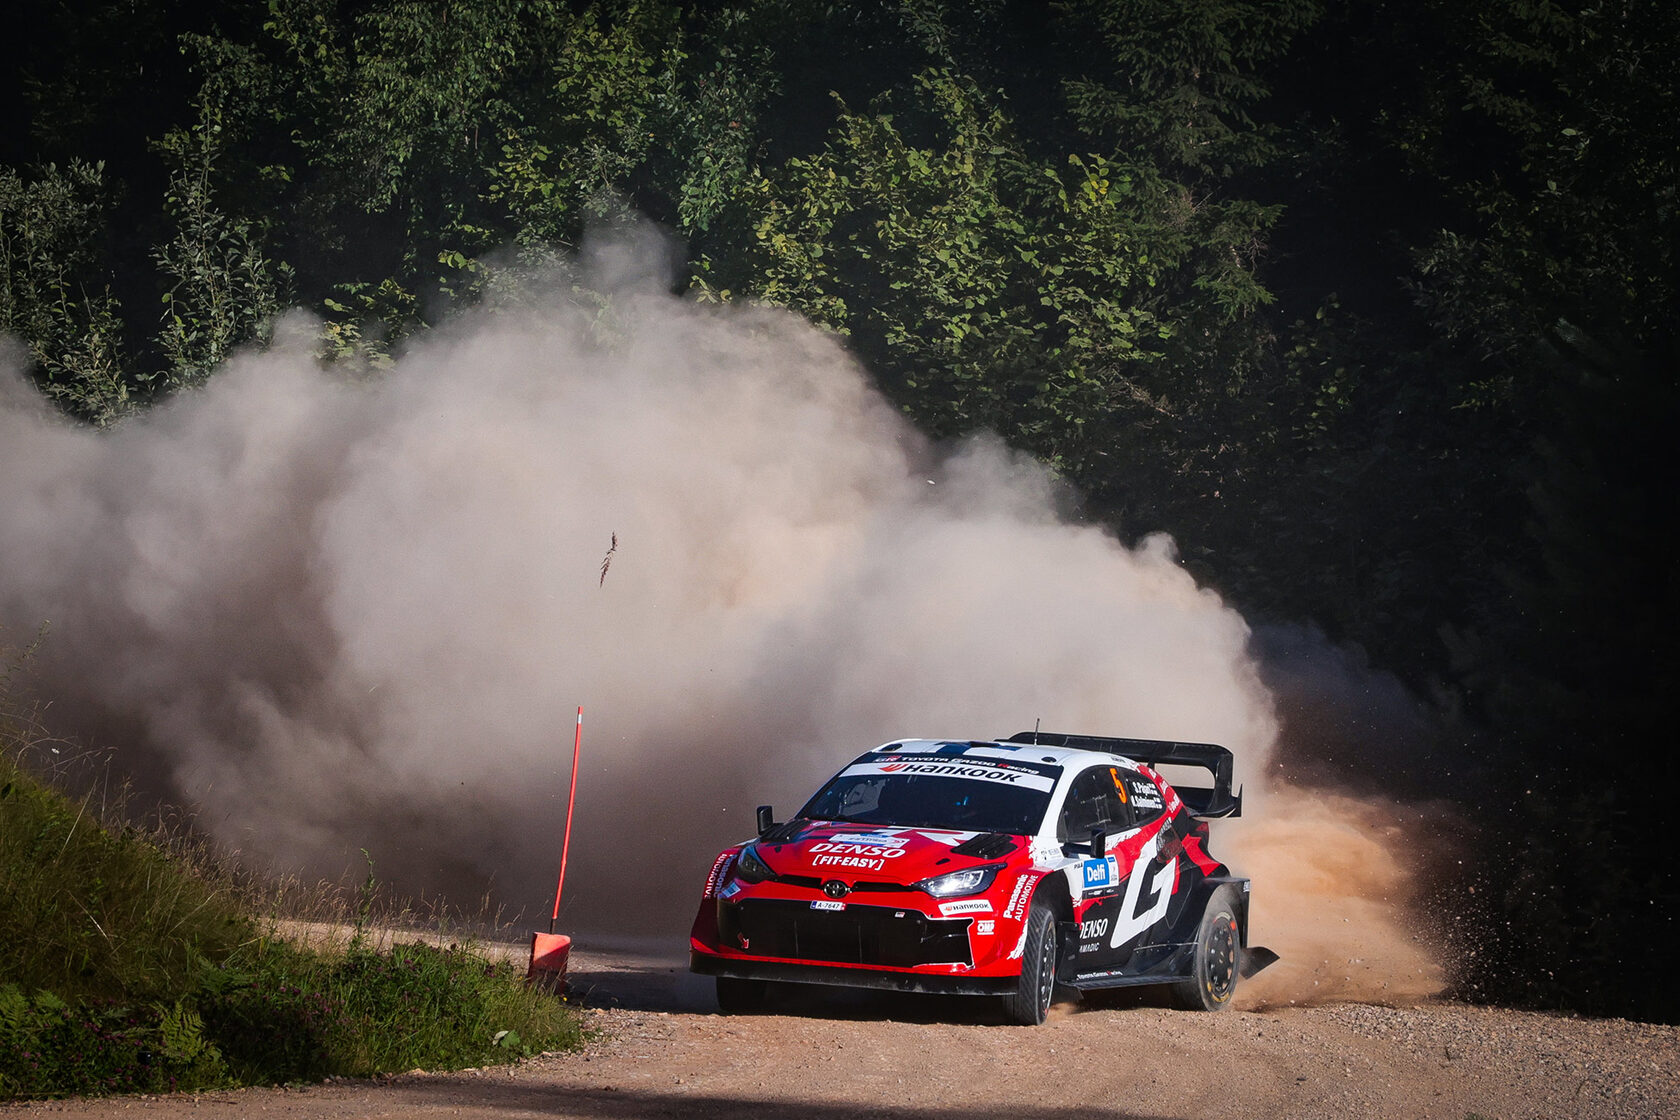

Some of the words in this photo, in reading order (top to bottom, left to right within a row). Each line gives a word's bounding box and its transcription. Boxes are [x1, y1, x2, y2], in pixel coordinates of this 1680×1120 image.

[950, 758, 997, 768] GAZOO
[997, 763, 1040, 775] Racing
[1109, 767, 1128, 804] 5
[808, 843, 906, 859] DENSO
[1086, 864, 1106, 882] Delfi
[1002, 874, 1029, 919] Panasonic
[1014, 875, 1039, 922] AUTOMOTIVE
[977, 921, 995, 934] OMP
